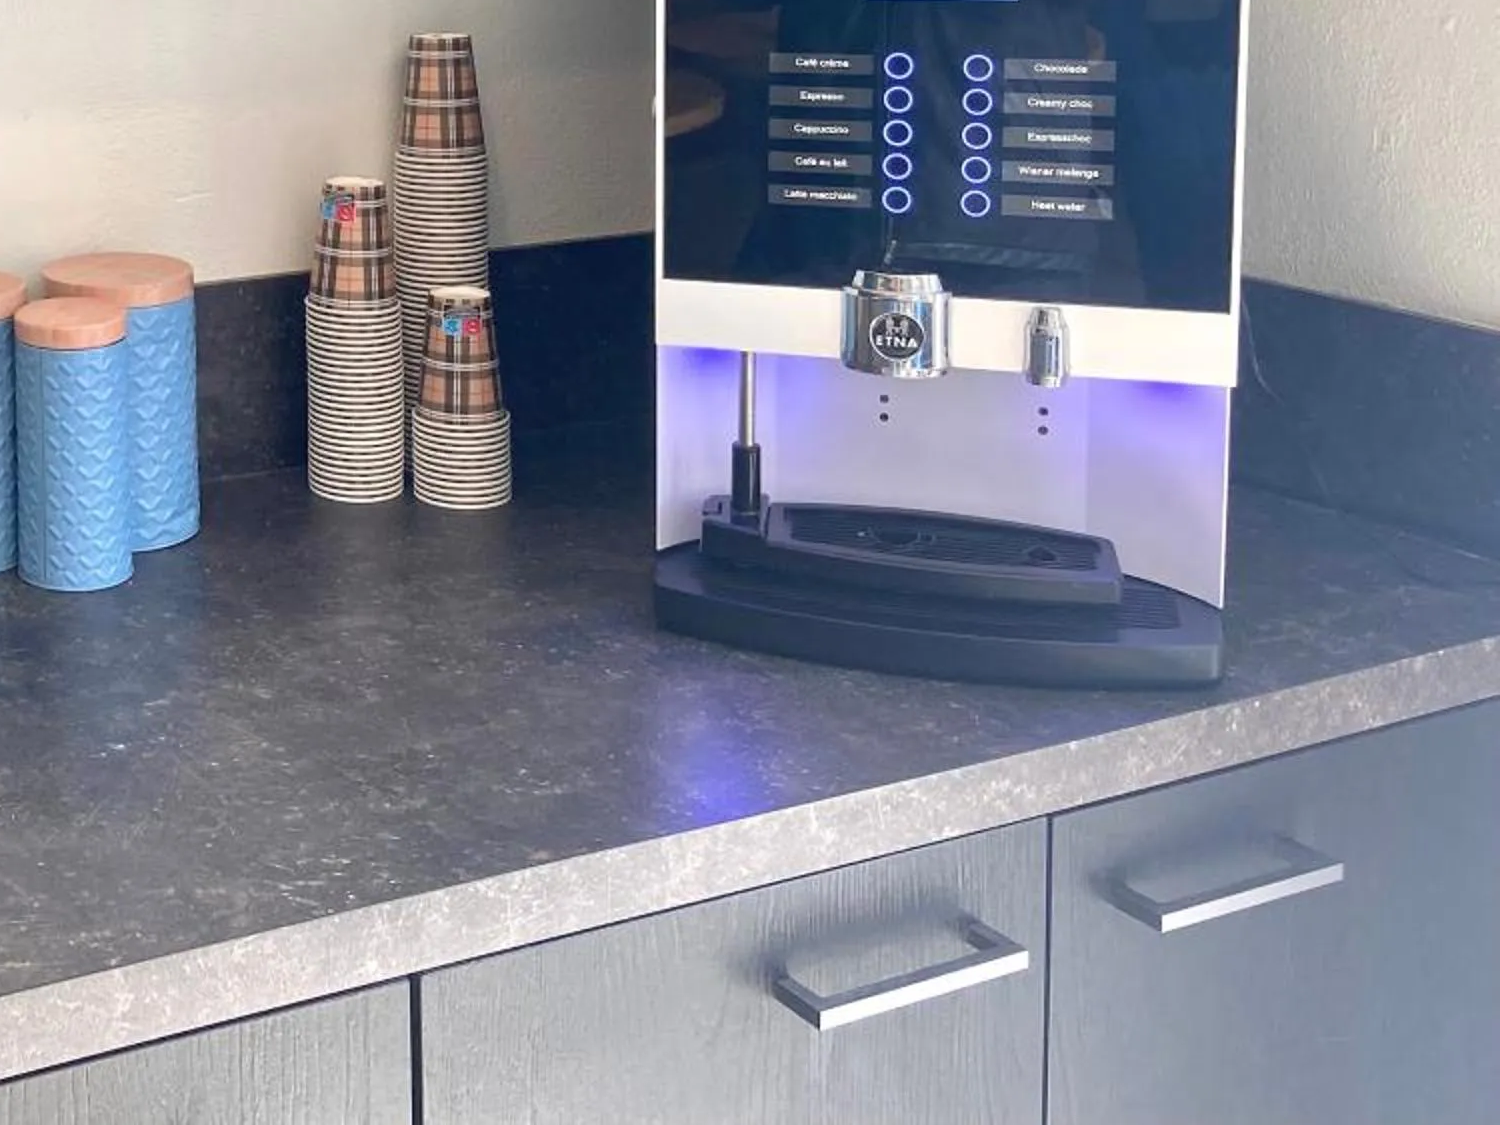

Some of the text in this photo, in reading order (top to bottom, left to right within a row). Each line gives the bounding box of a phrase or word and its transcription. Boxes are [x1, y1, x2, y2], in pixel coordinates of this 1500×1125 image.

[1033, 62, 1088, 74] Chocolade
[799, 90, 845, 102] Espresso
[1027, 97, 1093, 110] Creamy choc
[793, 123, 849, 135] Cappuccino
[1057, 202, 1087, 212] water
[875, 334, 919, 349] ETNA
